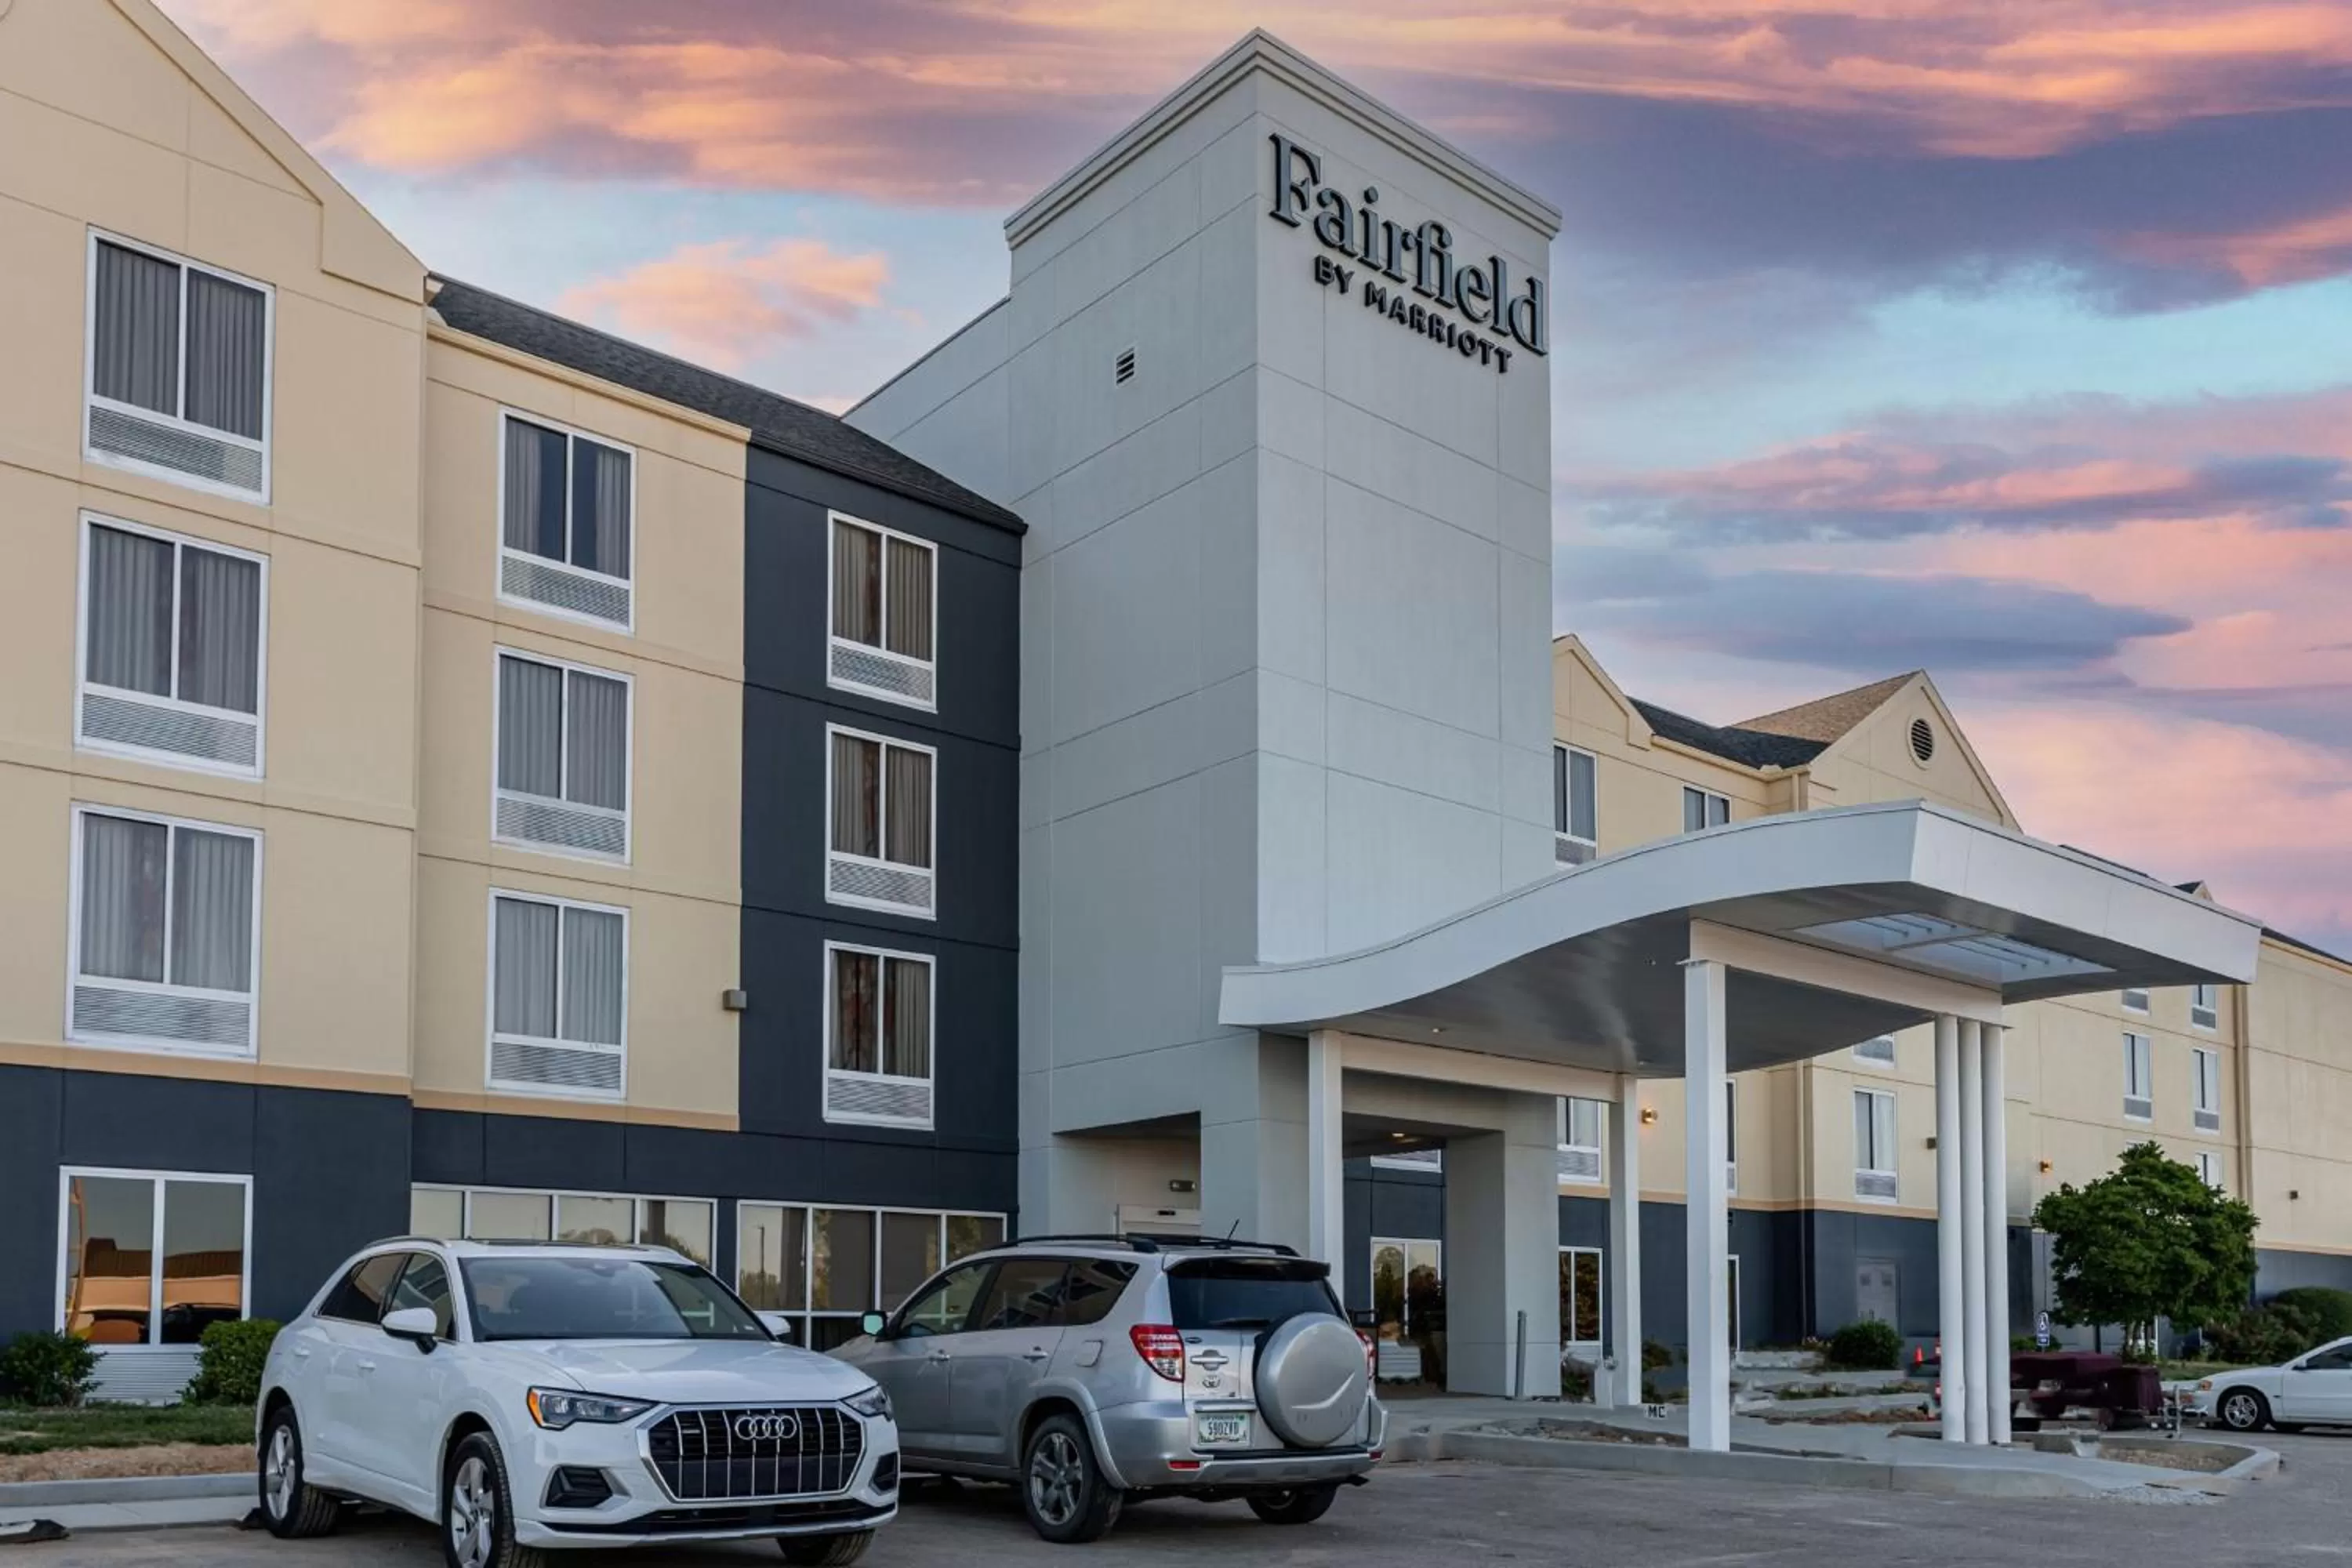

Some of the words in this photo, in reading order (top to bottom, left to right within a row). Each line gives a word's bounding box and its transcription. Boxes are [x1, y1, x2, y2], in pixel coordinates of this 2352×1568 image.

[1269, 132, 1548, 357] Fairfield
[1314, 254, 1356, 295] BY
[1364, 281, 1512, 373] MARRIOTT
